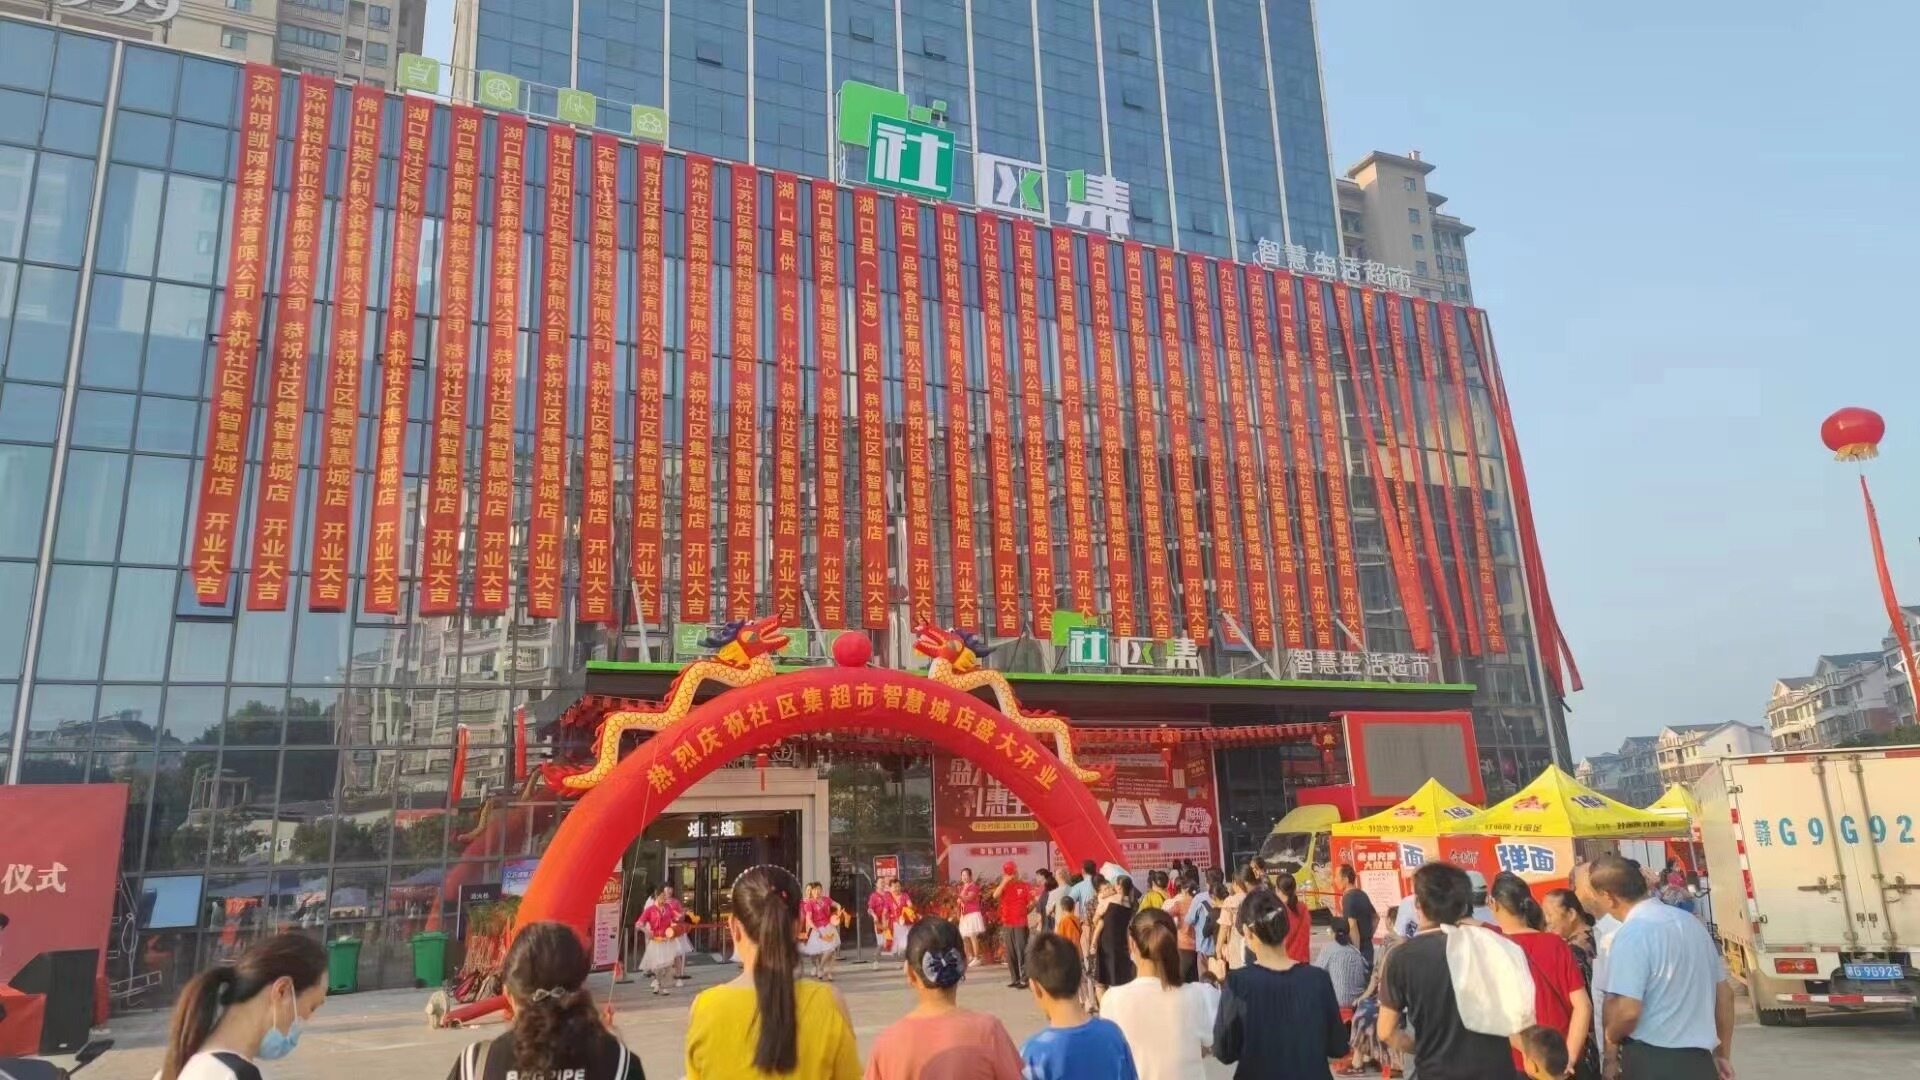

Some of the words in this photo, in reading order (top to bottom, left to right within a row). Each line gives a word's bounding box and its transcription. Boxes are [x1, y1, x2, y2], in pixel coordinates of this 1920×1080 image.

[235, 75, 272, 298] 苏州明凯网络科技有限公司
[447, 118, 475, 332] 湖口县鲜商集网络科技有限公司
[495, 126, 521, 338] 湖口县社区集网络科技有限公司
[593, 146, 615, 352] 无锡市社区集网络科技有限公司
[874, 122, 1130, 236] 社区集
[641, 156, 660, 358] 南京社区集网络科技有限公司
[690, 163, 707, 361] 苏州市社区集网络科技有限公司
[779, 182, 796, 374] 湖口县供合社
[818, 189, 836, 377] 湖口县商业资产管理运营中心
[900, 205, 921, 390] 江西一品香食品有限公司
[1257, 237, 1411, 290] 智慧生活超市
[1092, 244, 1115, 415] 湖口县孙中华贸易商行
[210, 310, 252, 496] 恭祝社区集智慧城店
[268, 322, 304, 502] 恭祝社区集智慧城店
[326, 329, 359, 505] 恭祝社区集智慧城店
[379, 330, 407, 504] 恭祝社区集智慧城店
[435, 344, 464, 513] 恭祝社区集智慧城店
[486, 349, 512, 516] 恭祝社区集智慧城店
[539, 353, 564, 518] 恭祝社区集智慧城店
[589, 361, 610, 524] 恭祝社区集智慧城店
[639, 368, 657, 528] 恭祝社区集智慧城店
[688, 370, 706, 528] 恭祝社区集智慧城店
[734, 382, 752, 536] 恭祝社区集智慧城店
[780, 383, 796, 534] 恭祝社区集智慧城店
[822, 387, 838, 538] 恭祝社区集智慧城店
[863, 393, 882, 540] 恭祝社区集智慧城店
[908, 400, 927, 544] 恭祝社区集智慧城店
[952, 404, 971, 548] 恭祝社区集智慧城店
[992, 410, 1013, 551] 恭祝社区集智慧城店
[1027, 415, 1048, 554] 恭祝社区集智慧城店
[1067, 420, 1088, 556] 恭祝社区集智慧城店
[1103, 426, 1125, 560] 恭祝社区集智慧城店
[1139, 430, 1162, 564] 恭祝社区集智慧城店
[1174, 434, 1198, 566] 恭祝社区集智慧城店
[1187, 578, 1205, 639] 开业大吉
[1208, 437, 1231, 567] 恭祝社区集智慧城店
[1238, 441, 1261, 570] 恭祝社区集智慧城店
[1253, 582, 1269, 640] 开业大吉
[1268, 445, 1291, 572] 恭祝社区集智慧城店
[1283, 584, 1299, 642] 开业大吉
[1297, 448, 1320, 574] 恭祝社区集智慧城店
[1313, 586, 1329, 643] 开业大吉
[1327, 452, 1351, 575] 恭祝社区集智慧城店
[197, 512, 228, 593] 开业大吉
[258, 518, 285, 600] 开业大吉
[319, 522, 344, 598] 开业大吉
[375, 522, 395, 603] 开业大吉
[429, 529, 452, 602] 开业大吉
[482, 532, 504, 601] 开业大吉
[534, 534, 555, 608] 开业大吉
[587, 539, 606, 613] 开业大吉
[638, 542, 656, 615] 开业大吉
[687, 543, 704, 614] 开业大吉
[733, 550, 750, 620] 开业大吉
[779, 548, 795, 621] 开业大吉
[958, 561, 973, 626] 开业大吉
[1000, 564, 1017, 628] 开业大吉
[1035, 568, 1052, 632] 开业大吉
[1076, 570, 1091, 616] 开业大
[1114, 574, 1131, 635] 开业大吉
[1150, 576, 1167, 637] 开业大吉
[1071, 630, 1198, 670] 社区集
[1296, 650, 1430, 676] 智慧生活超市
[646, 683, 1060, 793] 热烈庆祝社区集超市智慧城店盛大开业
[2, 863, 67, 894] 仪式
[1497, 844, 1554, 872] 弹面
